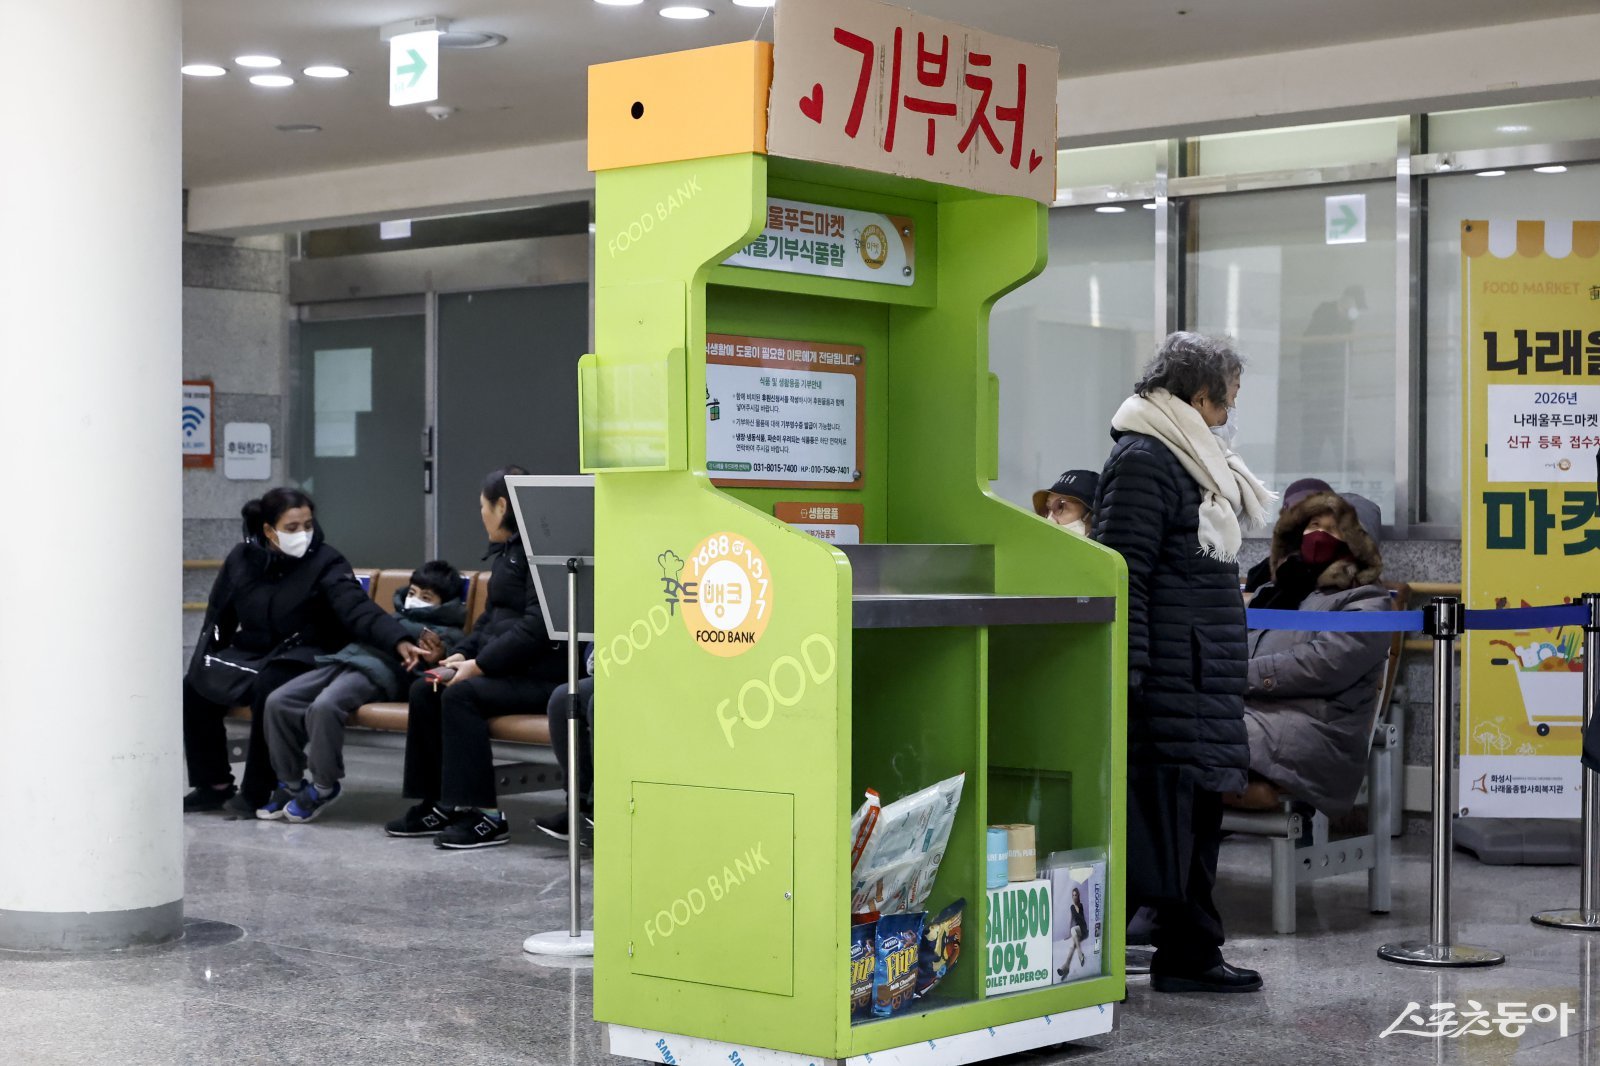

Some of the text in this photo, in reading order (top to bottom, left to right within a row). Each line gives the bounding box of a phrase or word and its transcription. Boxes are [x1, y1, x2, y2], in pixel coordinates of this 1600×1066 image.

[834, 26, 1026, 169] 기부처
[608, 174, 702, 258] FOOD BANK
[766, 205, 845, 239] 울푸드마켓
[1483, 281, 1581, 295] FOOD MARKET
[735, 345, 760, 359] 도움이
[761, 347, 785, 361] 필요한
[786, 349, 817, 363] 이웃에게
[1534, 391, 1578, 405] 2026년
[1514, 413, 1598, 428] 나래울푸드마켓
[1507, 435, 1532, 449] 신규
[1538, 435, 1562, 449] 등록
[753, 462, 798, 473] 031-8015-7400
[808, 507, 839, 520] 생활용품
[599, 605, 670, 678] FOOD
[696, 630, 755, 643] FOOD BANK
[716, 633, 836, 749] FOOD
[1490, 774, 1512, 783] 화성시
[644, 840, 770, 946] FOOD BANK
[1009, 970, 1034, 985] PAPER
